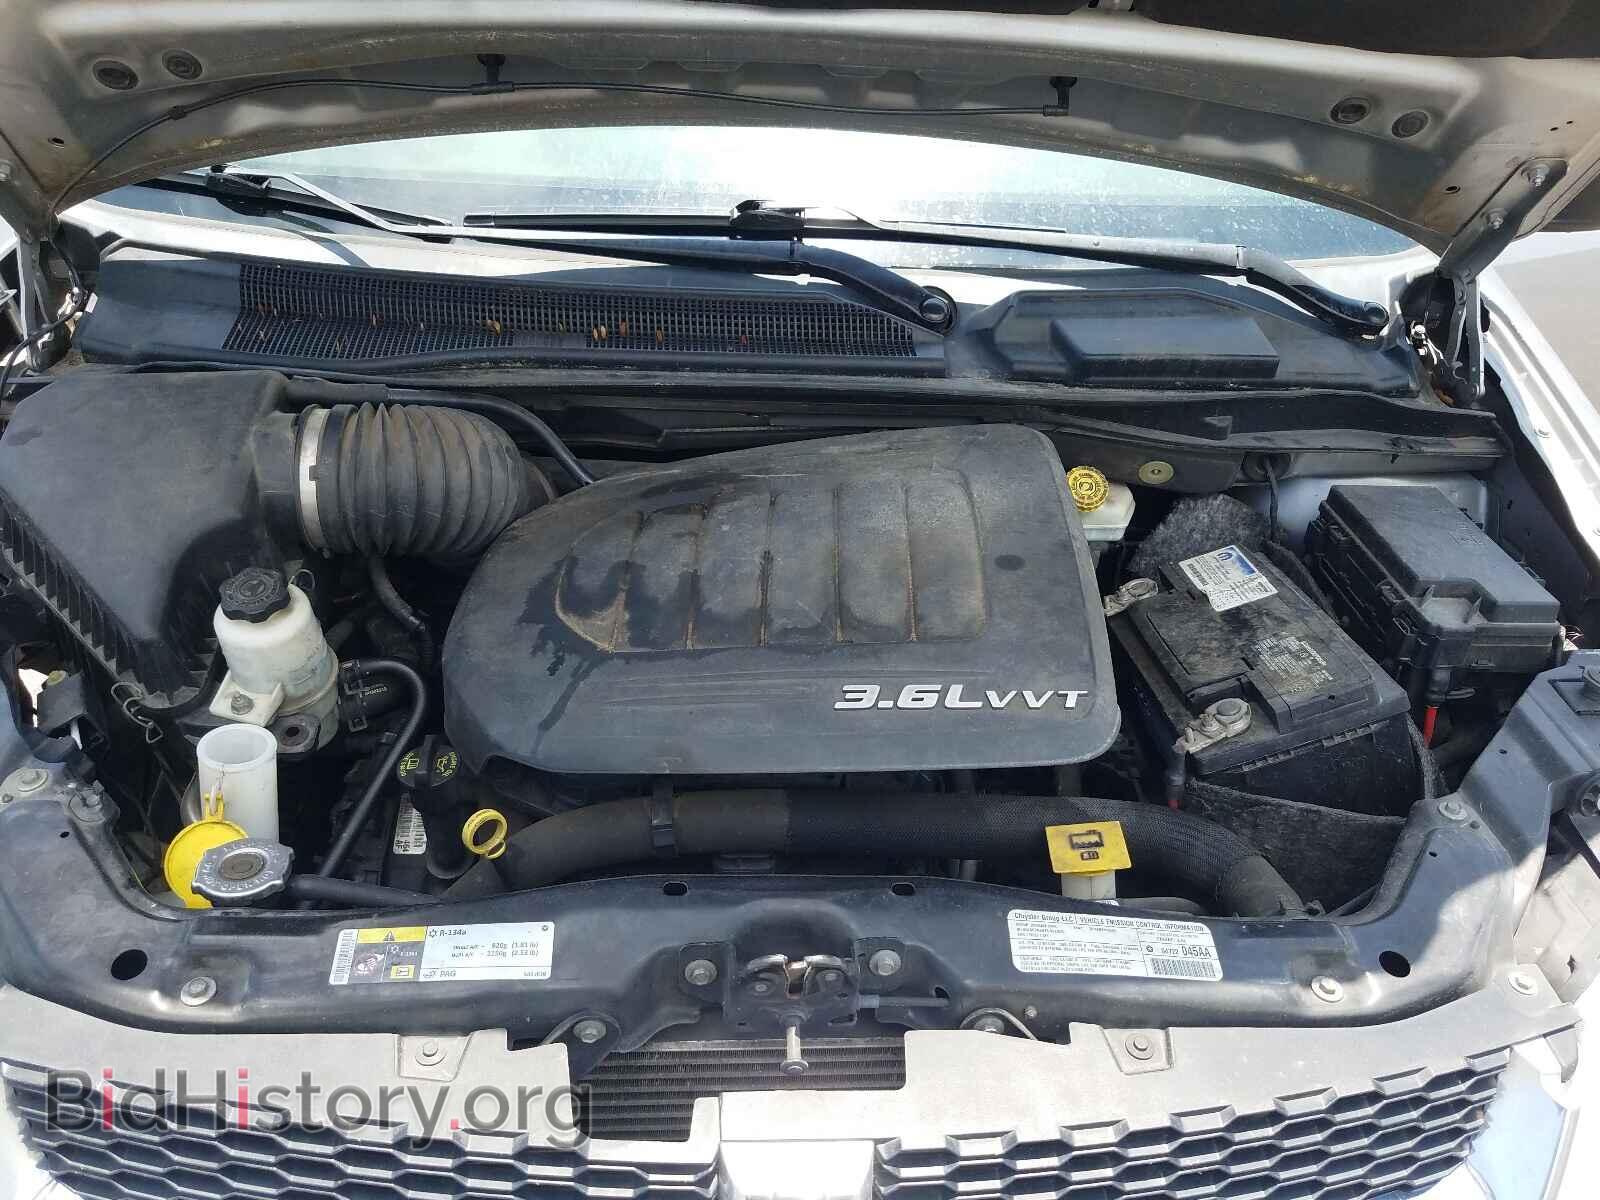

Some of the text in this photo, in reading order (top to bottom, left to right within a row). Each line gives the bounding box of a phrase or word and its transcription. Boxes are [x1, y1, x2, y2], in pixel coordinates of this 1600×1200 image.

[834, 684, 1089, 709] 3.6L VVT
[1135, 921, 1161, 929] CONTROL
[1164, 923, 1204, 931] INFORMATION
[439, 928, 467, 936] R-134a
[1181, 946, 1212, 957] 045AA
